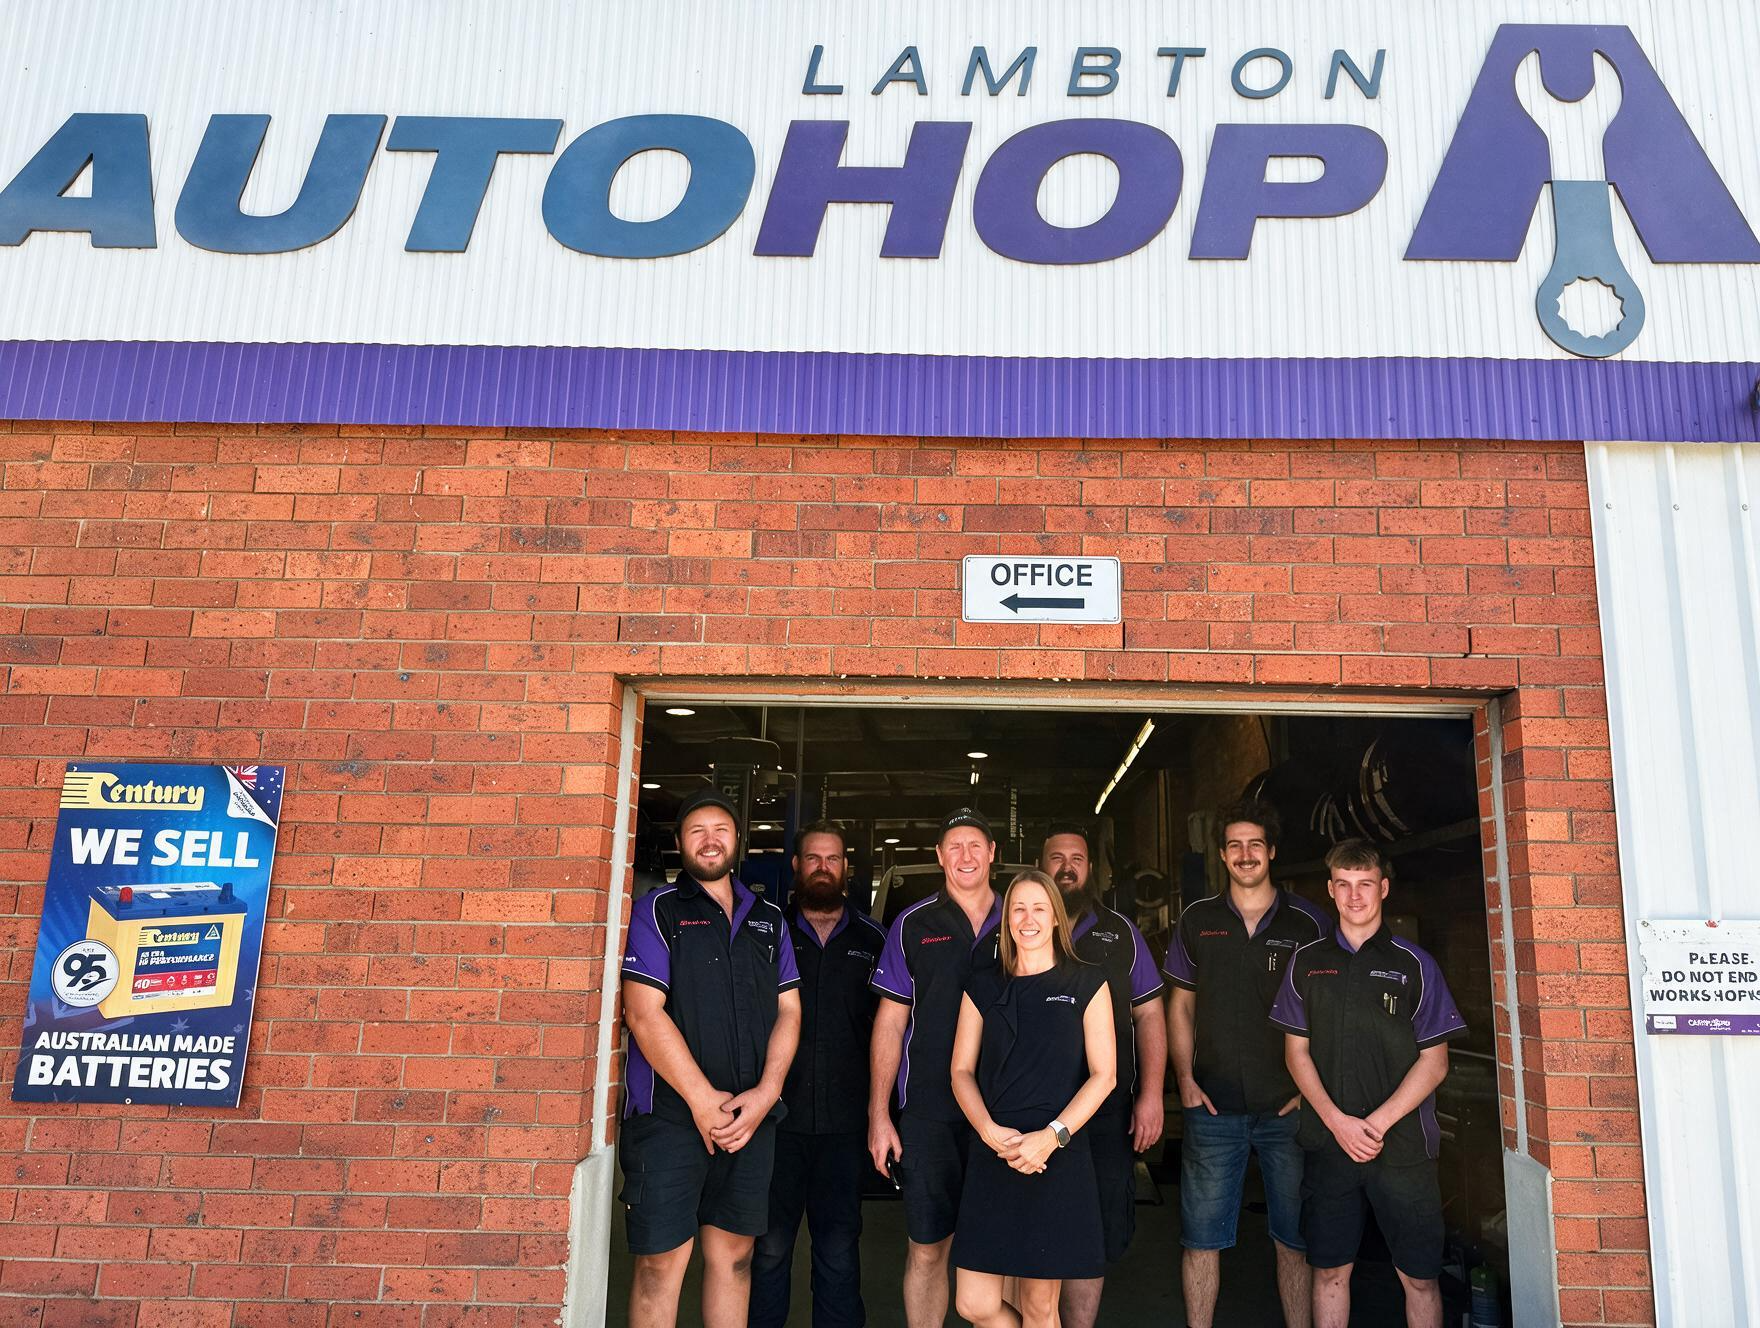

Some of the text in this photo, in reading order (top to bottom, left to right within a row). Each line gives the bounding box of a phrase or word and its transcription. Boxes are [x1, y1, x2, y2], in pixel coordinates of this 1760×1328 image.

[802, 45, 1386, 99] LAMBTON
[991, 563, 1092, 586] OFFICE
[72, 772, 205, 811] Century
[70, 828, 259, 867] WE SELL
[63, 953, 107, 988] 95
[1662, 971, 1686, 983] DO
[1690, 971, 1723, 983] NOT
[35, 1032, 235, 1054] AUSTRALIAN MADE
[28, 1054, 232, 1091] BATTERIES
